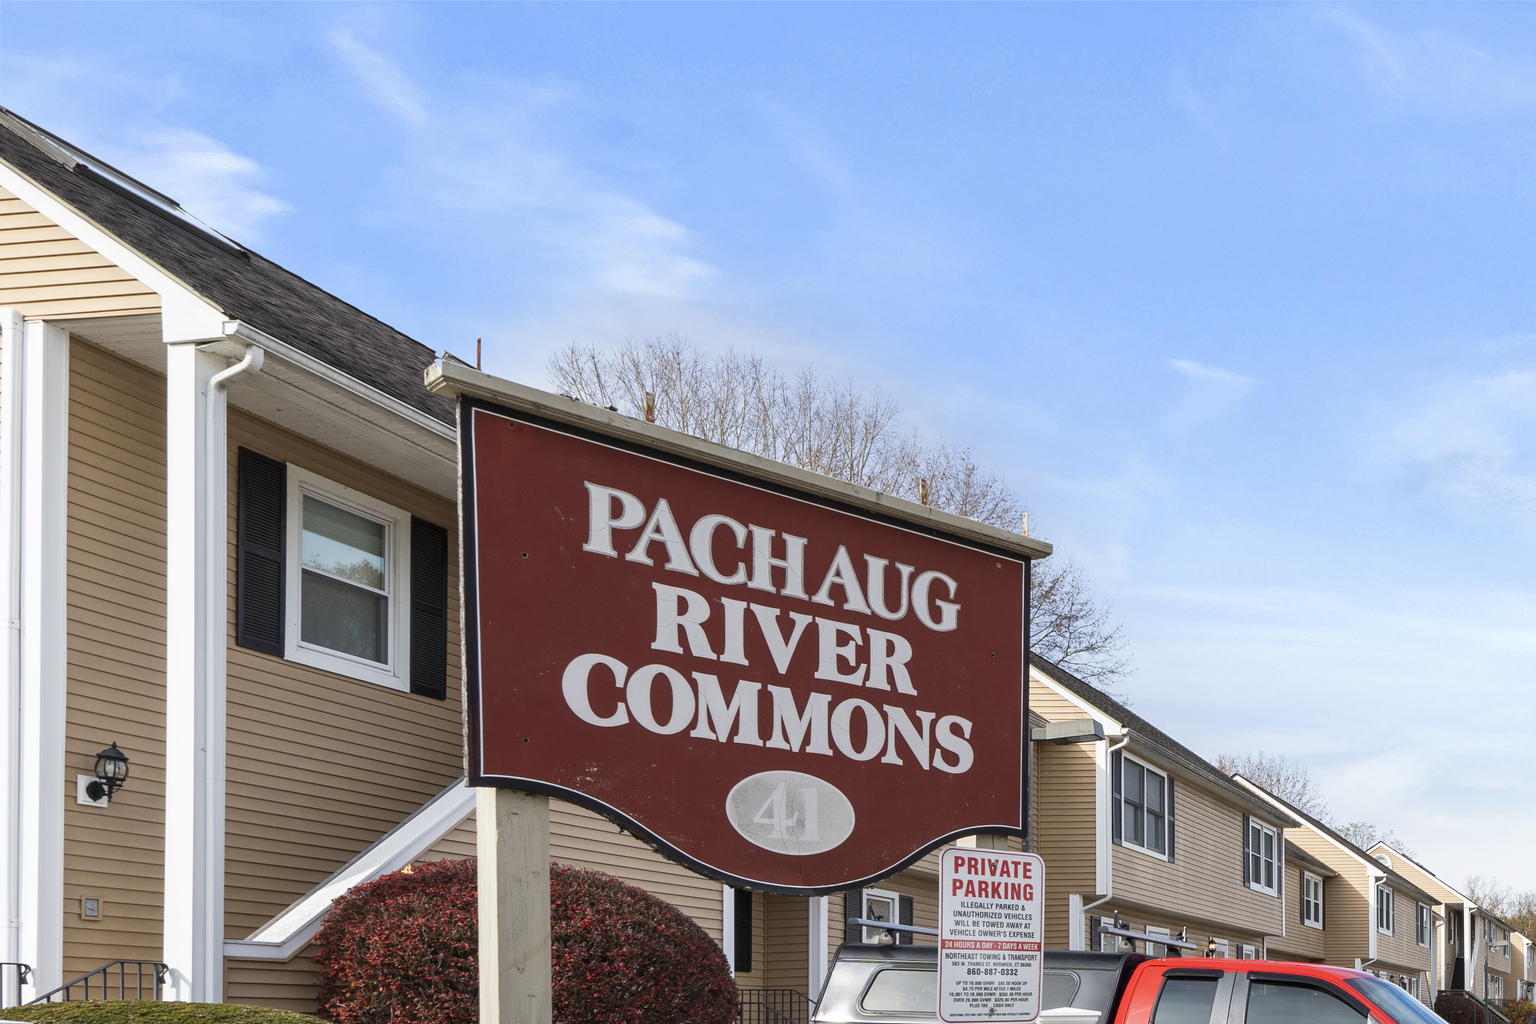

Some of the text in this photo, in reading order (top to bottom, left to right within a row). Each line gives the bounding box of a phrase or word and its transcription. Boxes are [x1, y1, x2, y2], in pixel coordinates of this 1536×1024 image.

[582, 480, 961, 633] PACHAUG
[650, 581, 918, 696] RIVER
[561, 653, 974, 775] COMMONS
[752, 781, 821, 843] 41
[954, 855, 1032, 880] PRIVATE
[952, 878, 1034, 902] PARKING
[960, 901, 994, 910] ILLEGALLY
[995, 903, 1020, 911] PARKED
[953, 910, 1033, 921] UNAUTHORIZED VEHICLES
[954, 919, 970, 927] WILL
[982, 920, 1004, 929] TOWED
[1023, 922, 1031, 930] AT
[949, 929, 1035, 939] VEHICLE OWNER'S EXPENSE
[953, 941, 975, 949] HOURS
[997, 942, 1001, 950] 7
[1022, 943, 1039, 951] WEEK
[945, 952, 978, 960] NORTHEAST
[979, 953, 1001, 961] TOWING
[1007, 953, 1037, 961] TRANSPORT
